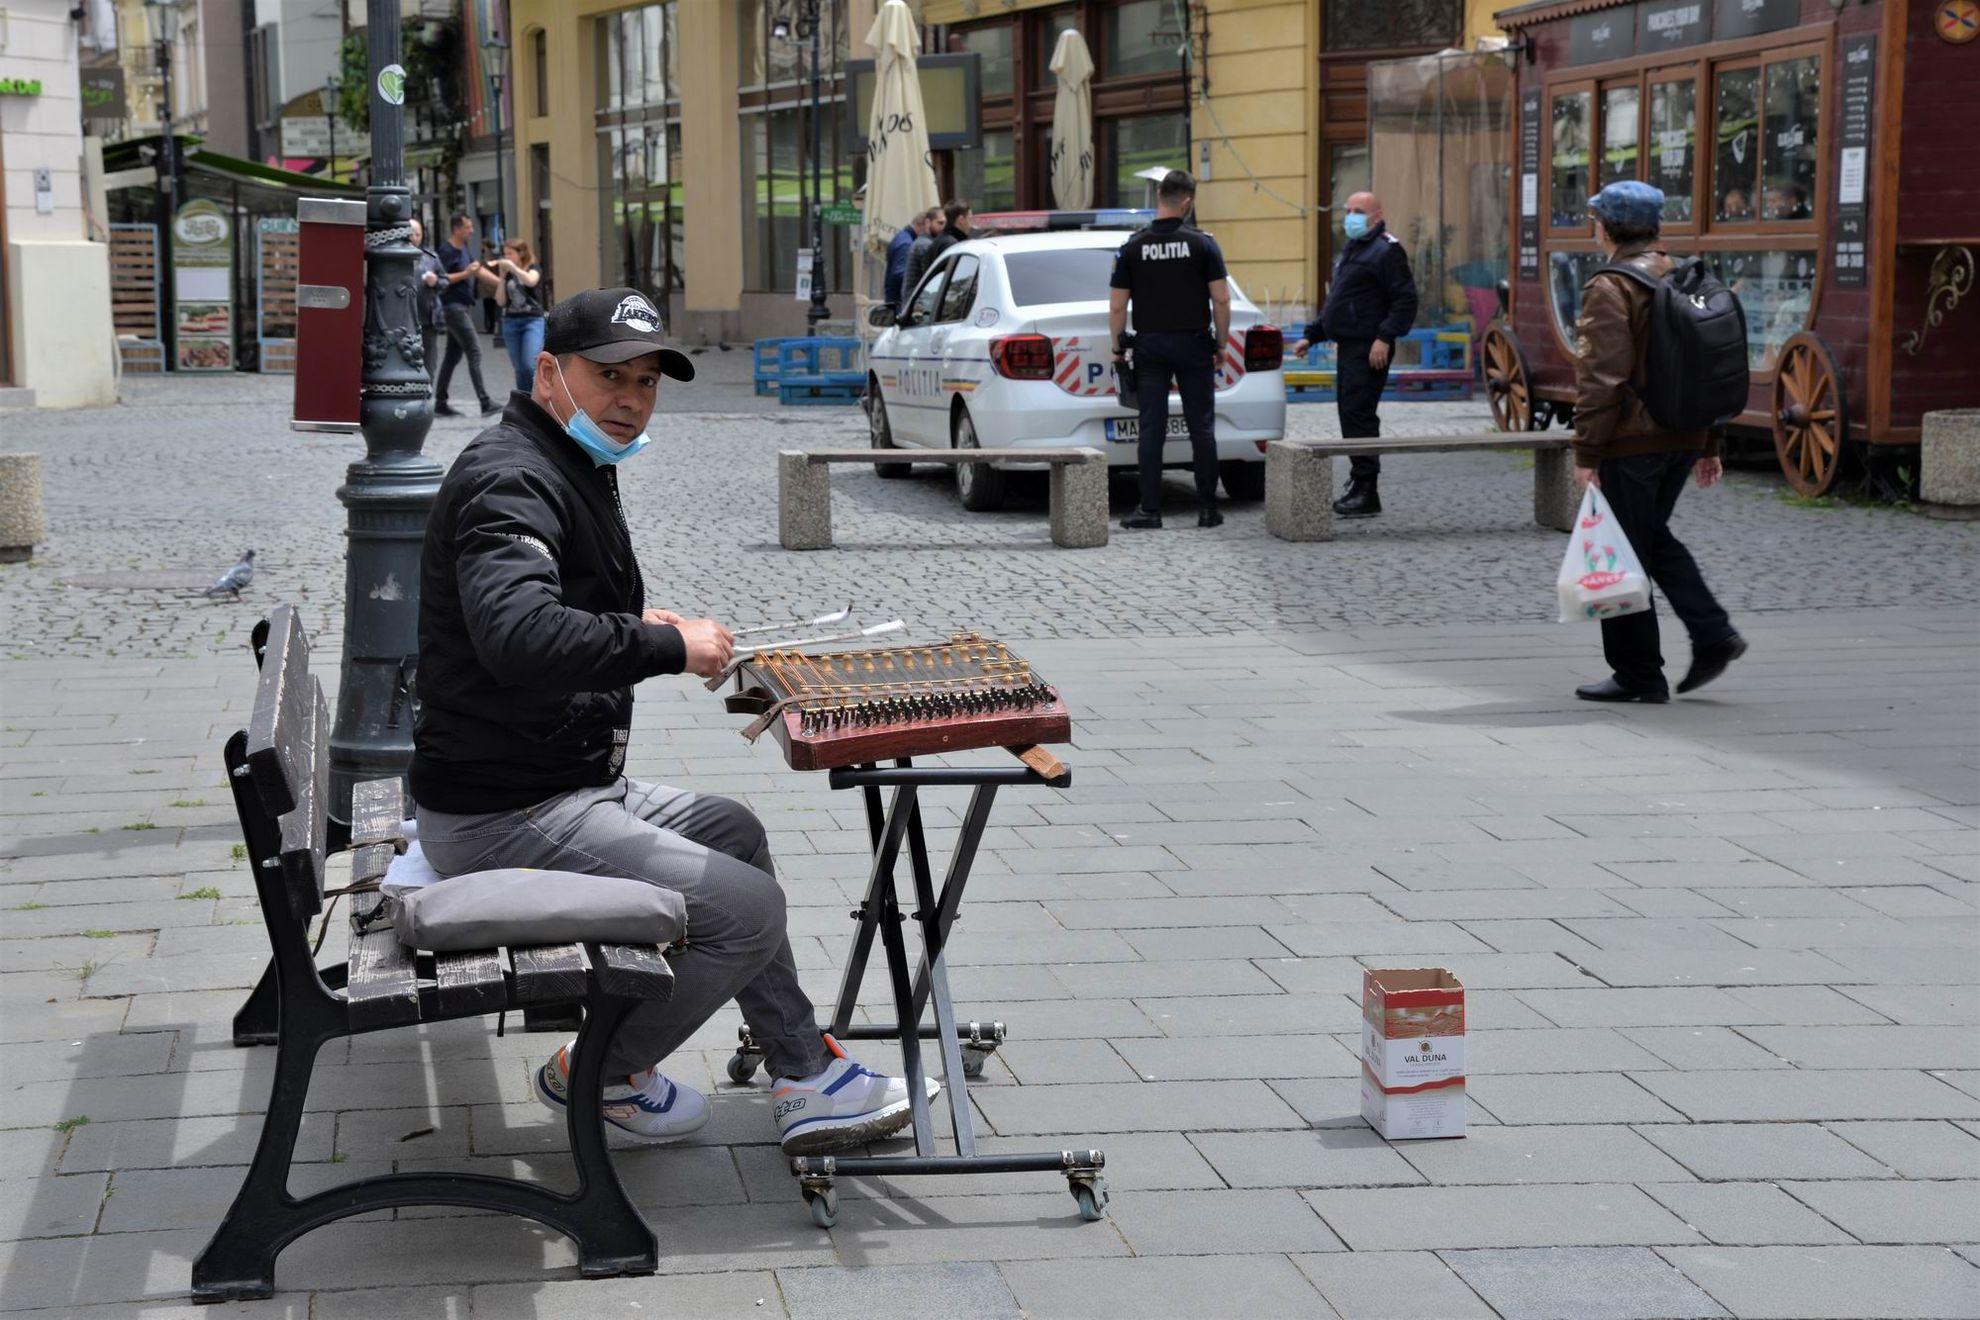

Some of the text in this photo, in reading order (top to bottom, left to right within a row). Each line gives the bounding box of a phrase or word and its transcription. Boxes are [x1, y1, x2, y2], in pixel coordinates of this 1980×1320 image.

[1142, 241, 1190, 261] POLITIA
[613, 303, 660, 331] LAKERS
[1404, 1054, 1447, 1064] VAL DUNA
